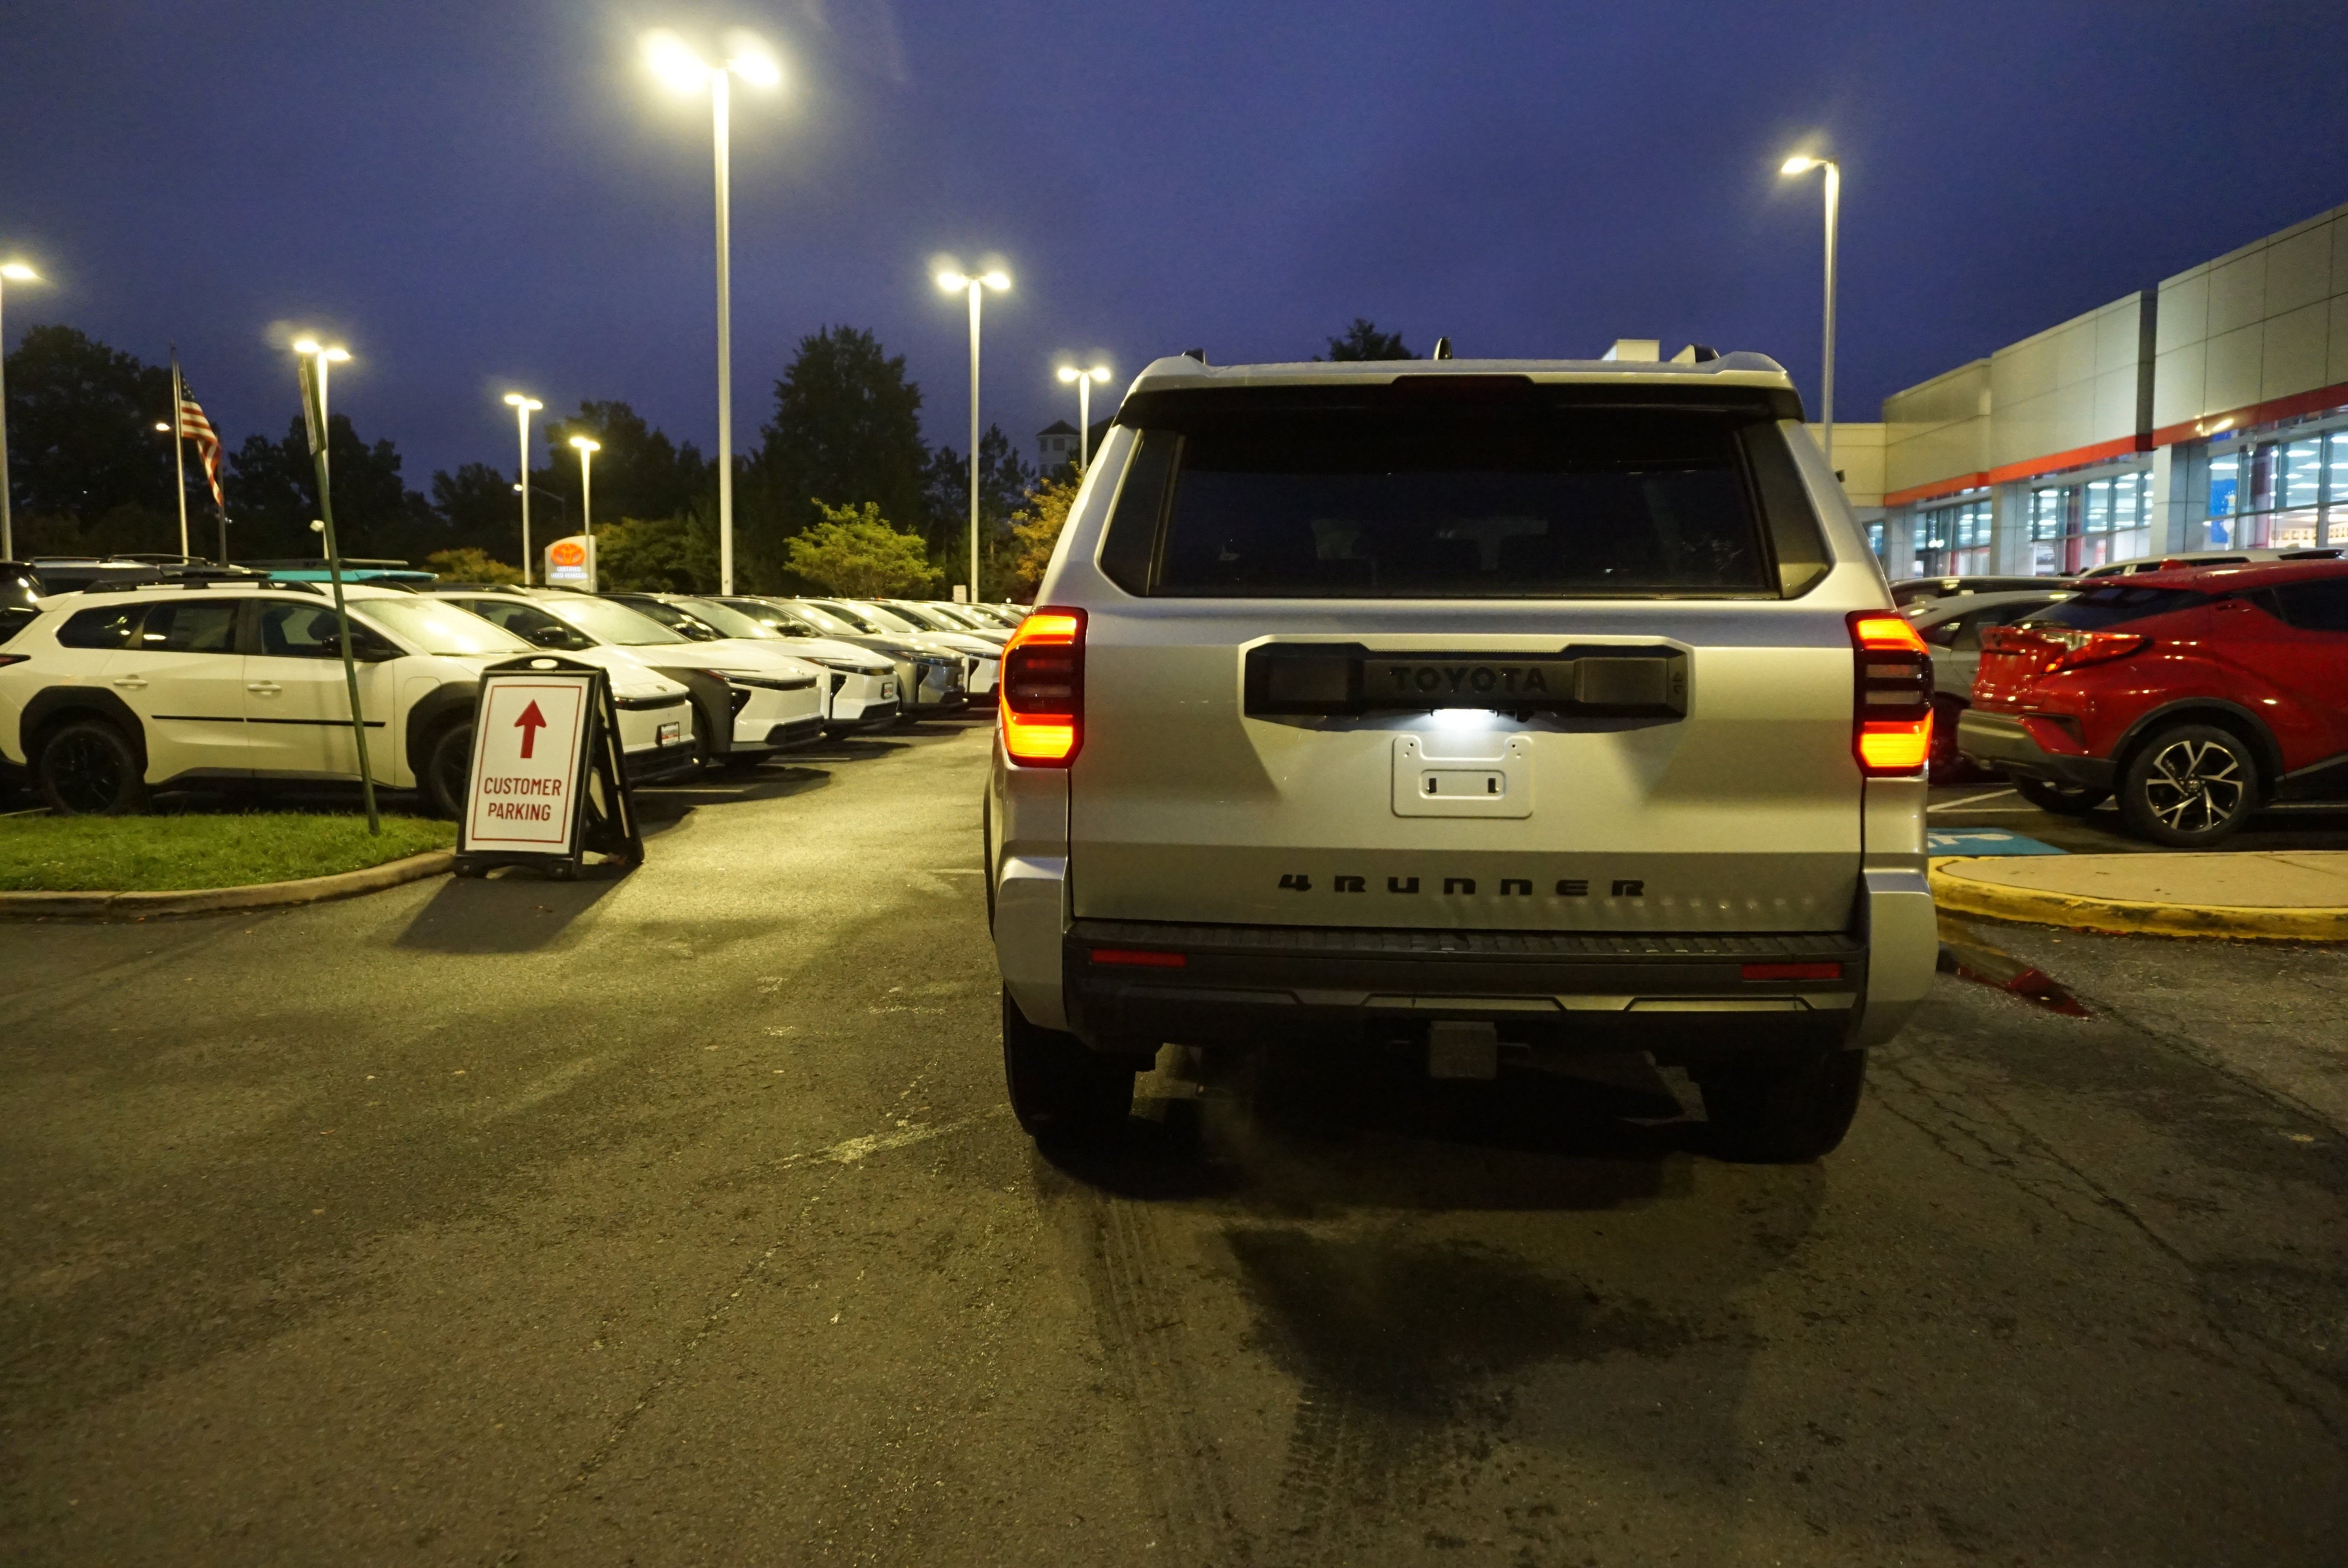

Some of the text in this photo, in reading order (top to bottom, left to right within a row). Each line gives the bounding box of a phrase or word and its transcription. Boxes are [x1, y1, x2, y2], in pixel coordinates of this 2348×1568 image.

[1389, 666, 1549, 692] TOYOTA
[483, 777, 562, 796] CUSTOMER
[487, 802, 551, 821] PARKING
